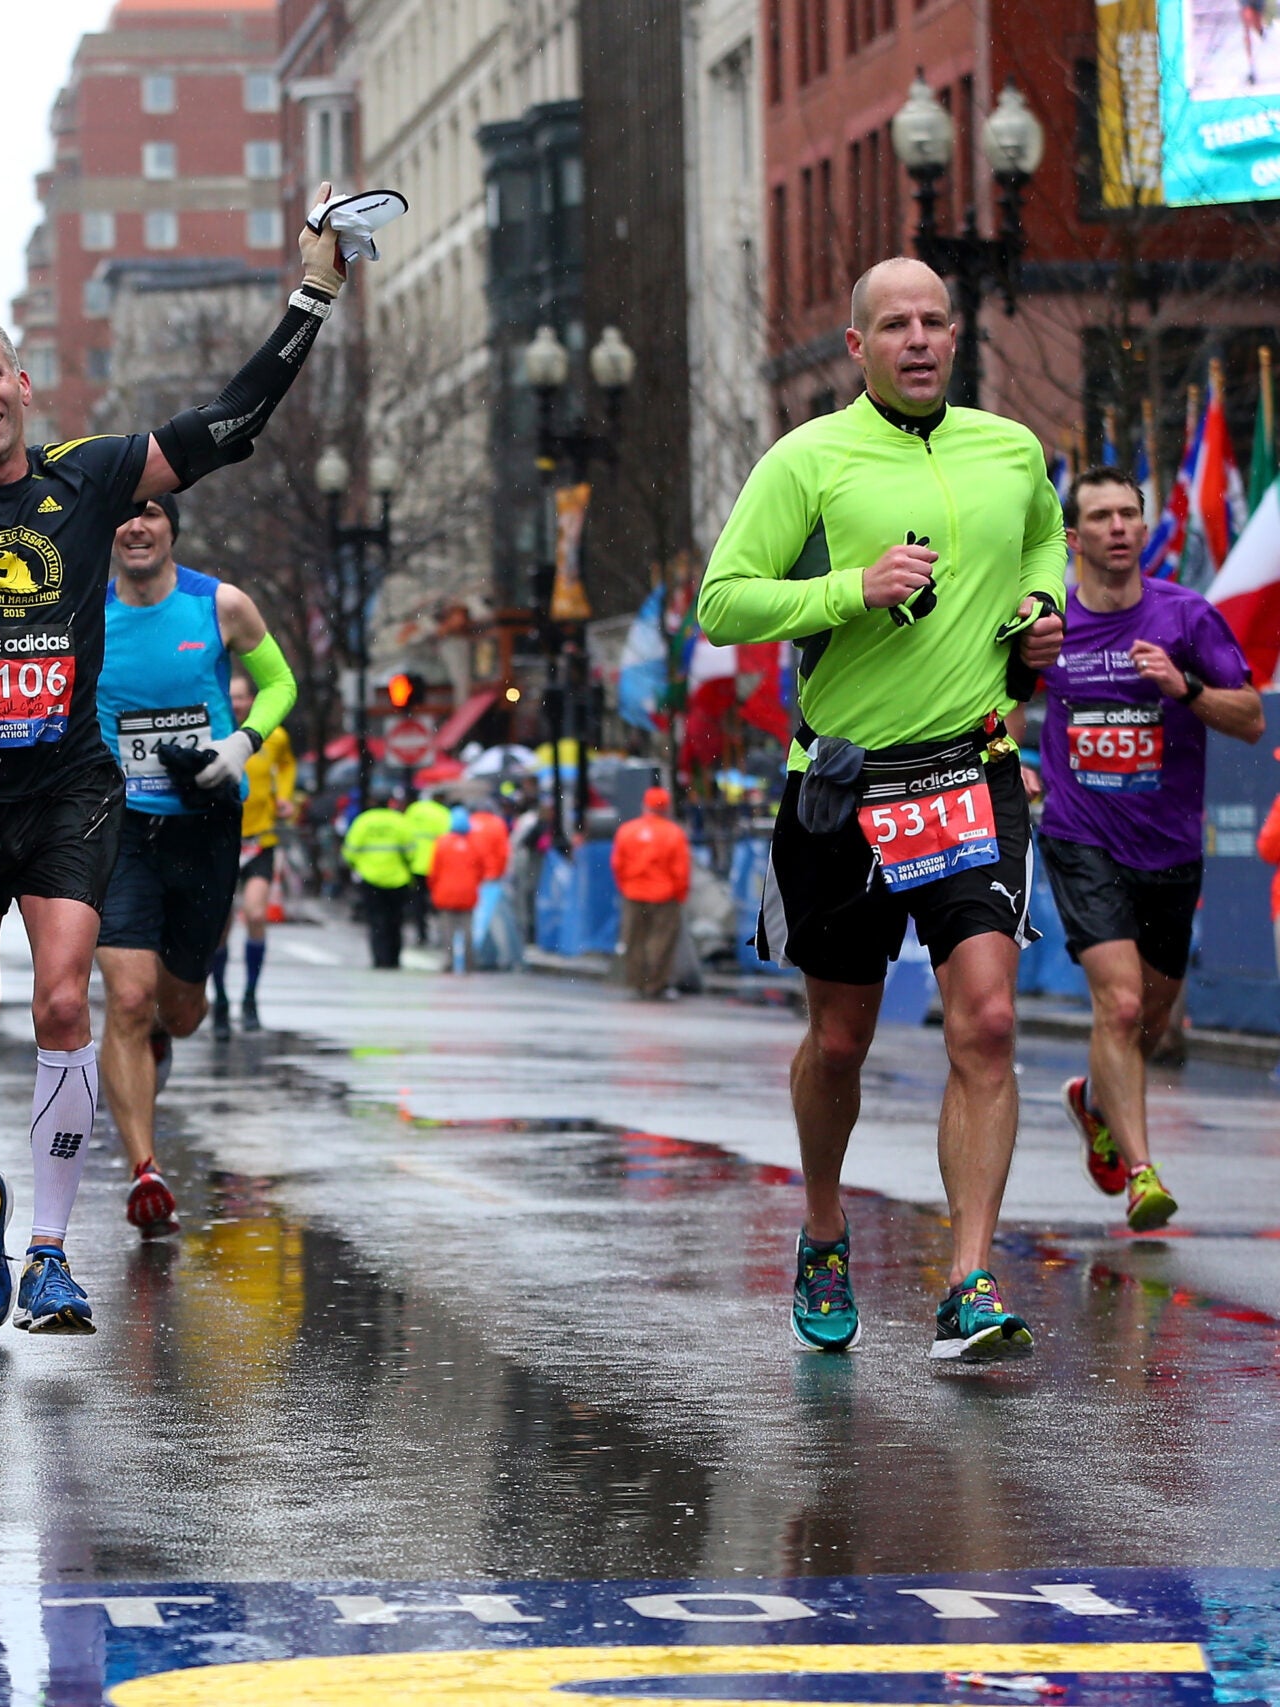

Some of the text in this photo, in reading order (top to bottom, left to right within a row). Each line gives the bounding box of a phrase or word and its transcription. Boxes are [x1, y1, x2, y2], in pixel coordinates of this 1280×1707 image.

[37, 505, 63, 513] adidas
[8, 590, 61, 604] MARATHON
[3, 608, 26, 618] 2015
[4, 633, 70, 652] adidas
[1111, 651, 1129, 660] TEA
[154, 711, 207, 728] adidas
[1106, 708, 1159, 724] adidas
[0, 723, 29, 731] BOSTON
[1077, 730, 1155, 759] 6655
[909, 768, 980, 793] adidas
[871, 789, 976, 842] 5311
[897, 861, 914, 874] 2015
[916, 855, 945, 870] BOSTON
[899, 862, 946, 882] MARATHON
[49, 1148, 77, 1160] cep
